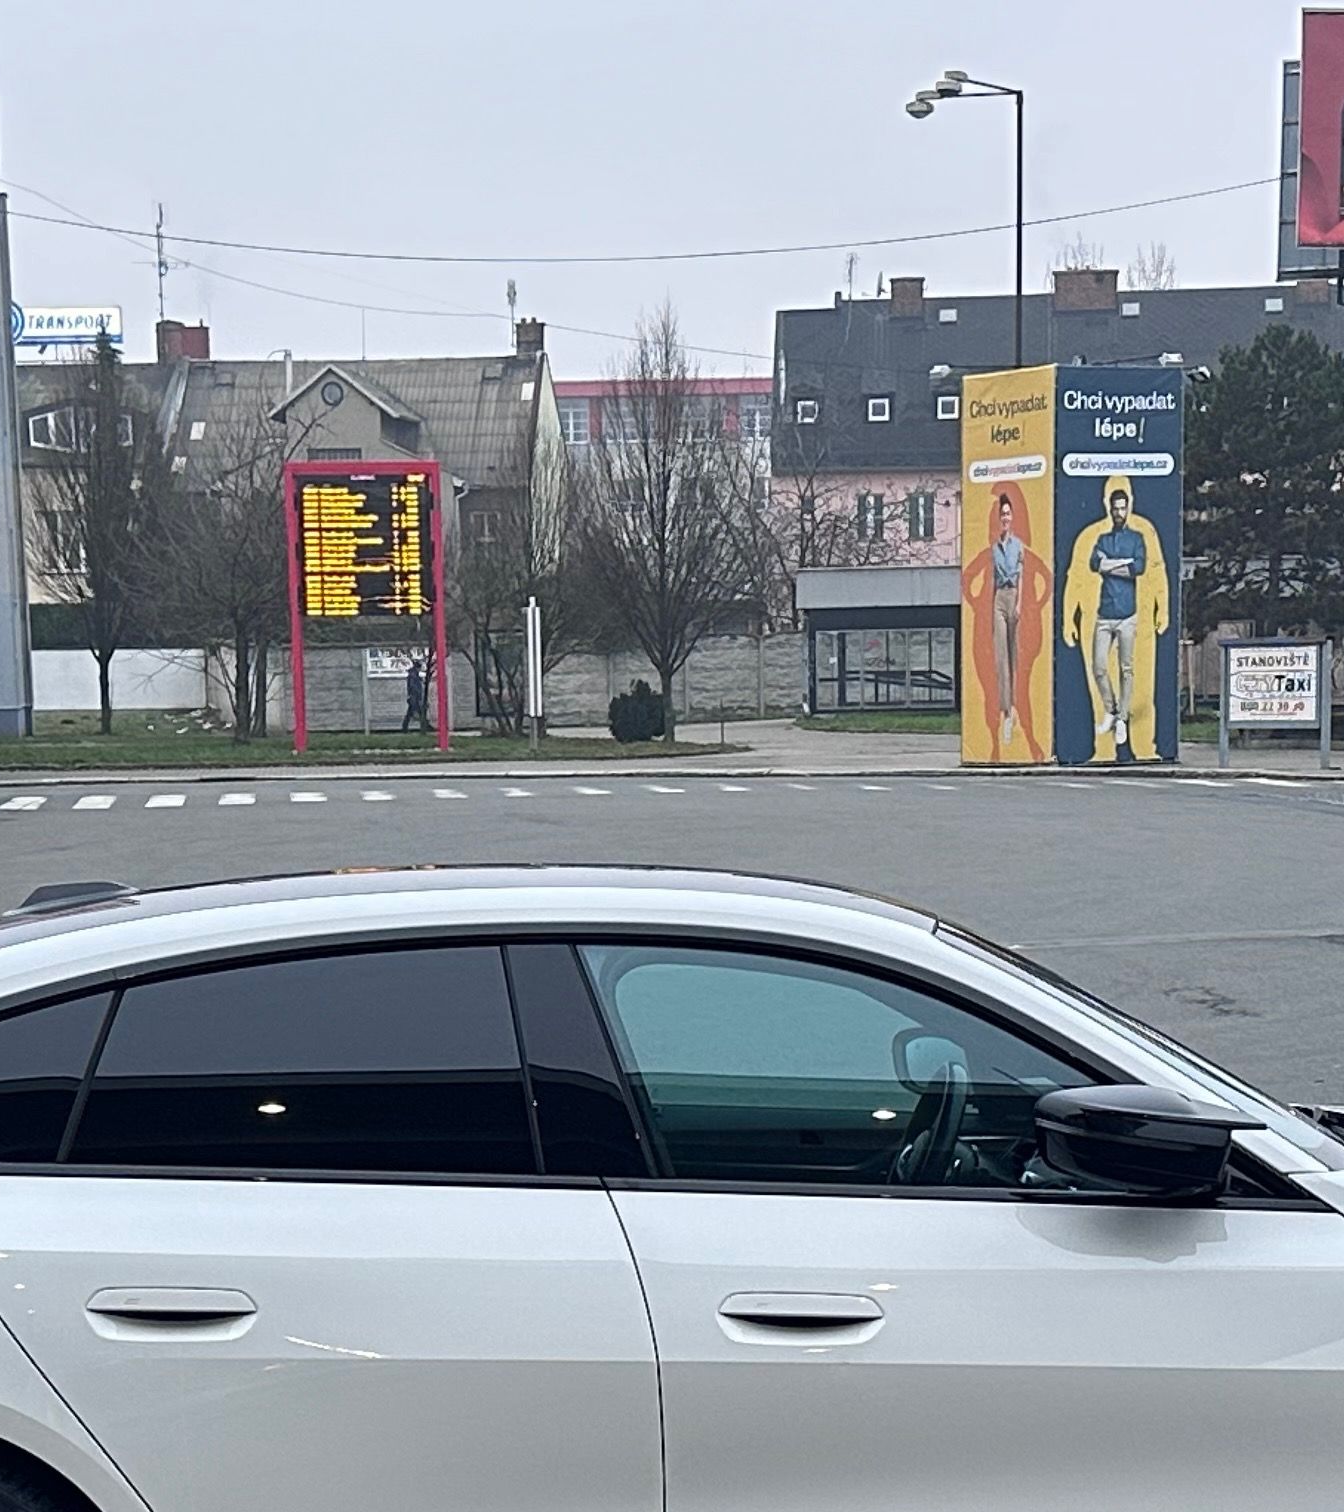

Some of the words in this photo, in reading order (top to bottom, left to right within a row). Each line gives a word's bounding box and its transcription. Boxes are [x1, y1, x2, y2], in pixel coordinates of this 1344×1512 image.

[997, 395, 1048, 418] vypadat
[1063, 390, 1102, 410] Chci
[1105, 390, 1176, 414] vypadat
